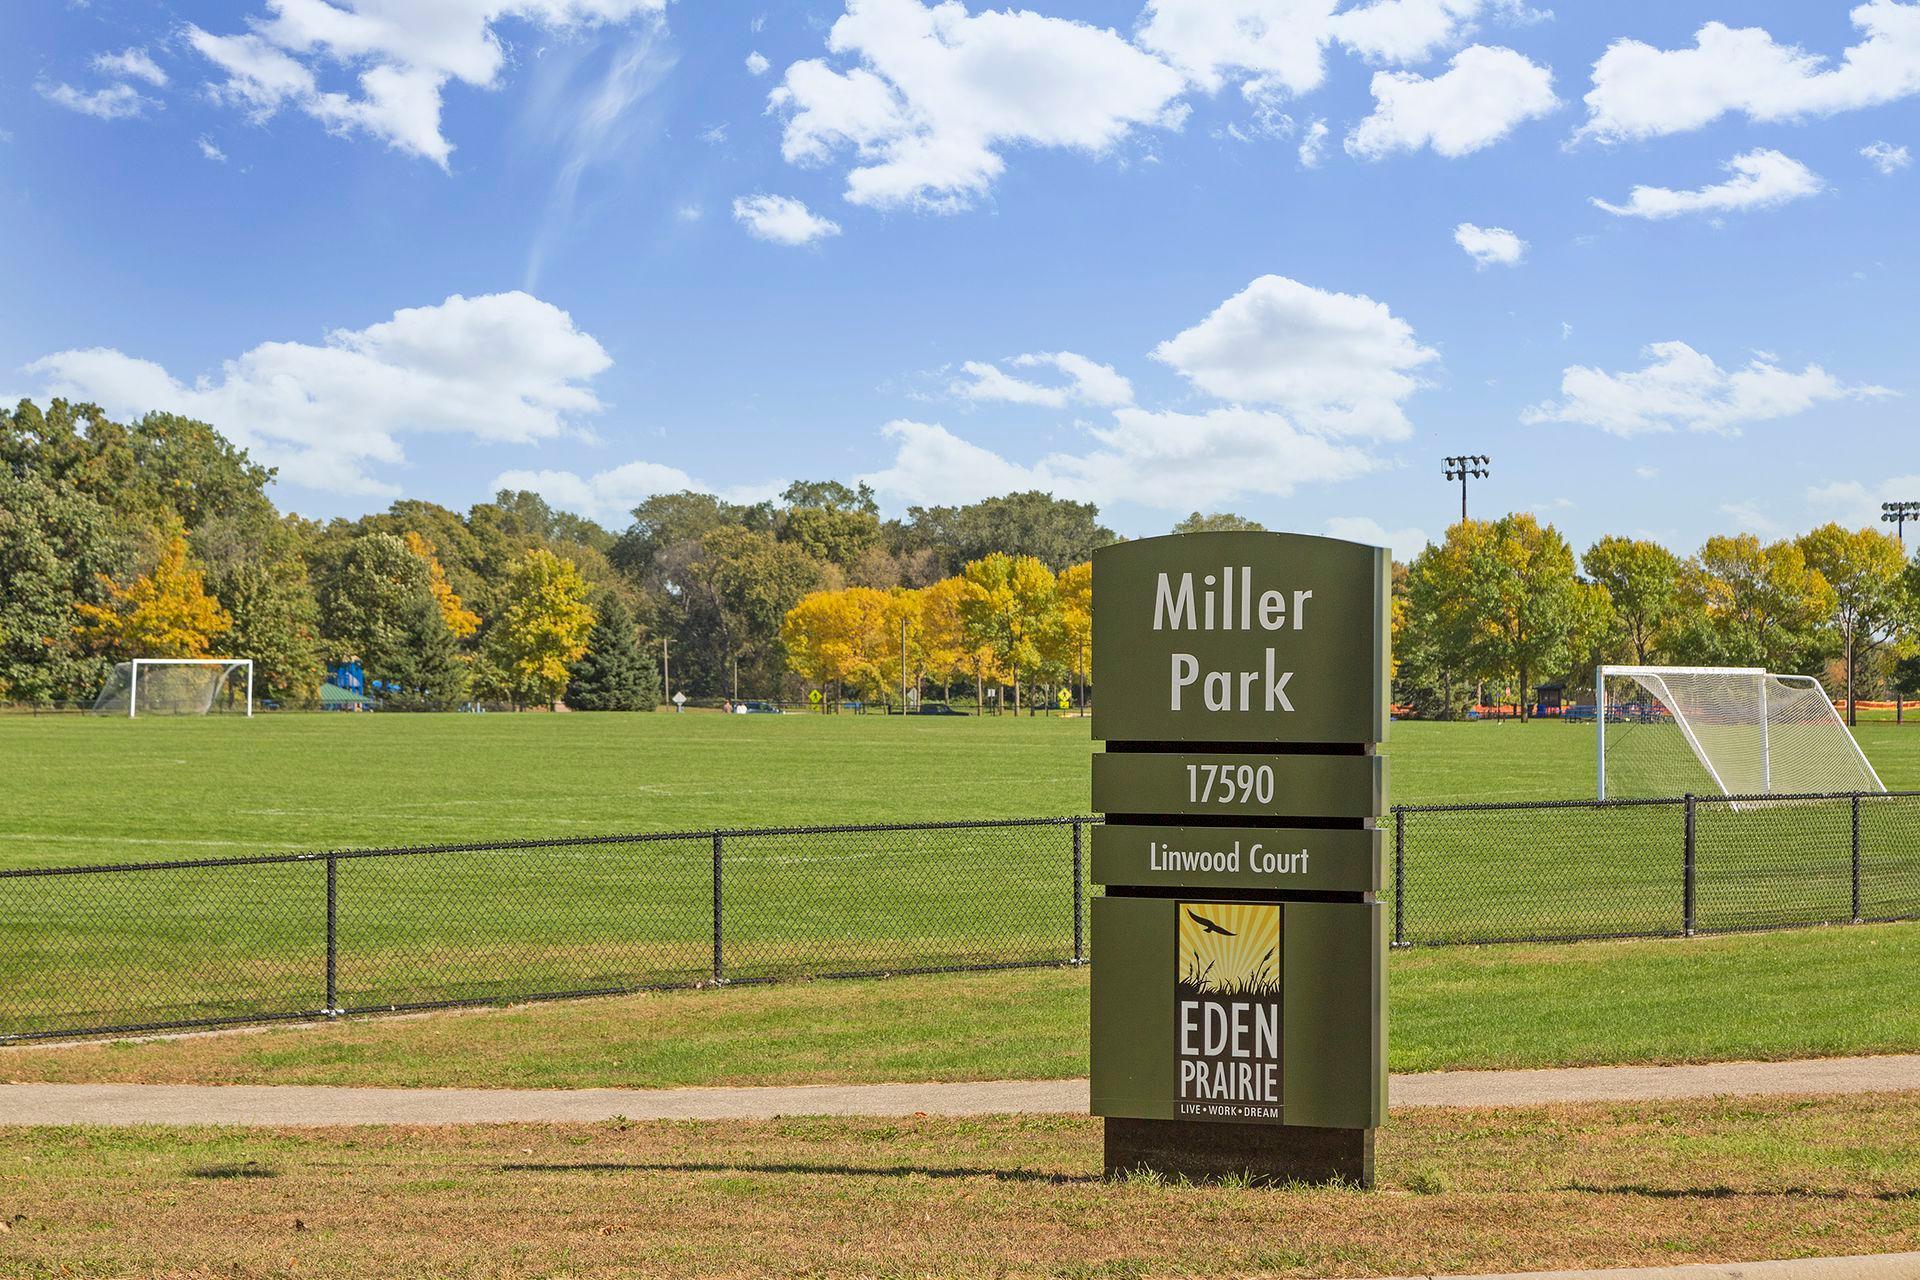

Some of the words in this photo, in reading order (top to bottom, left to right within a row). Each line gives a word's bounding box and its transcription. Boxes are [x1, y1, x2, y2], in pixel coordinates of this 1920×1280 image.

[1153, 567, 1312, 630] Miller
[1171, 648, 1294, 711] Park
[1187, 765, 1274, 803] 17590
[1151, 841, 1239, 872] Linwood
[1250, 844, 1309, 873] Court
[1182, 1001, 1277, 1058] EDEN
[1181, 1060, 1277, 1101] PRAIRIE
